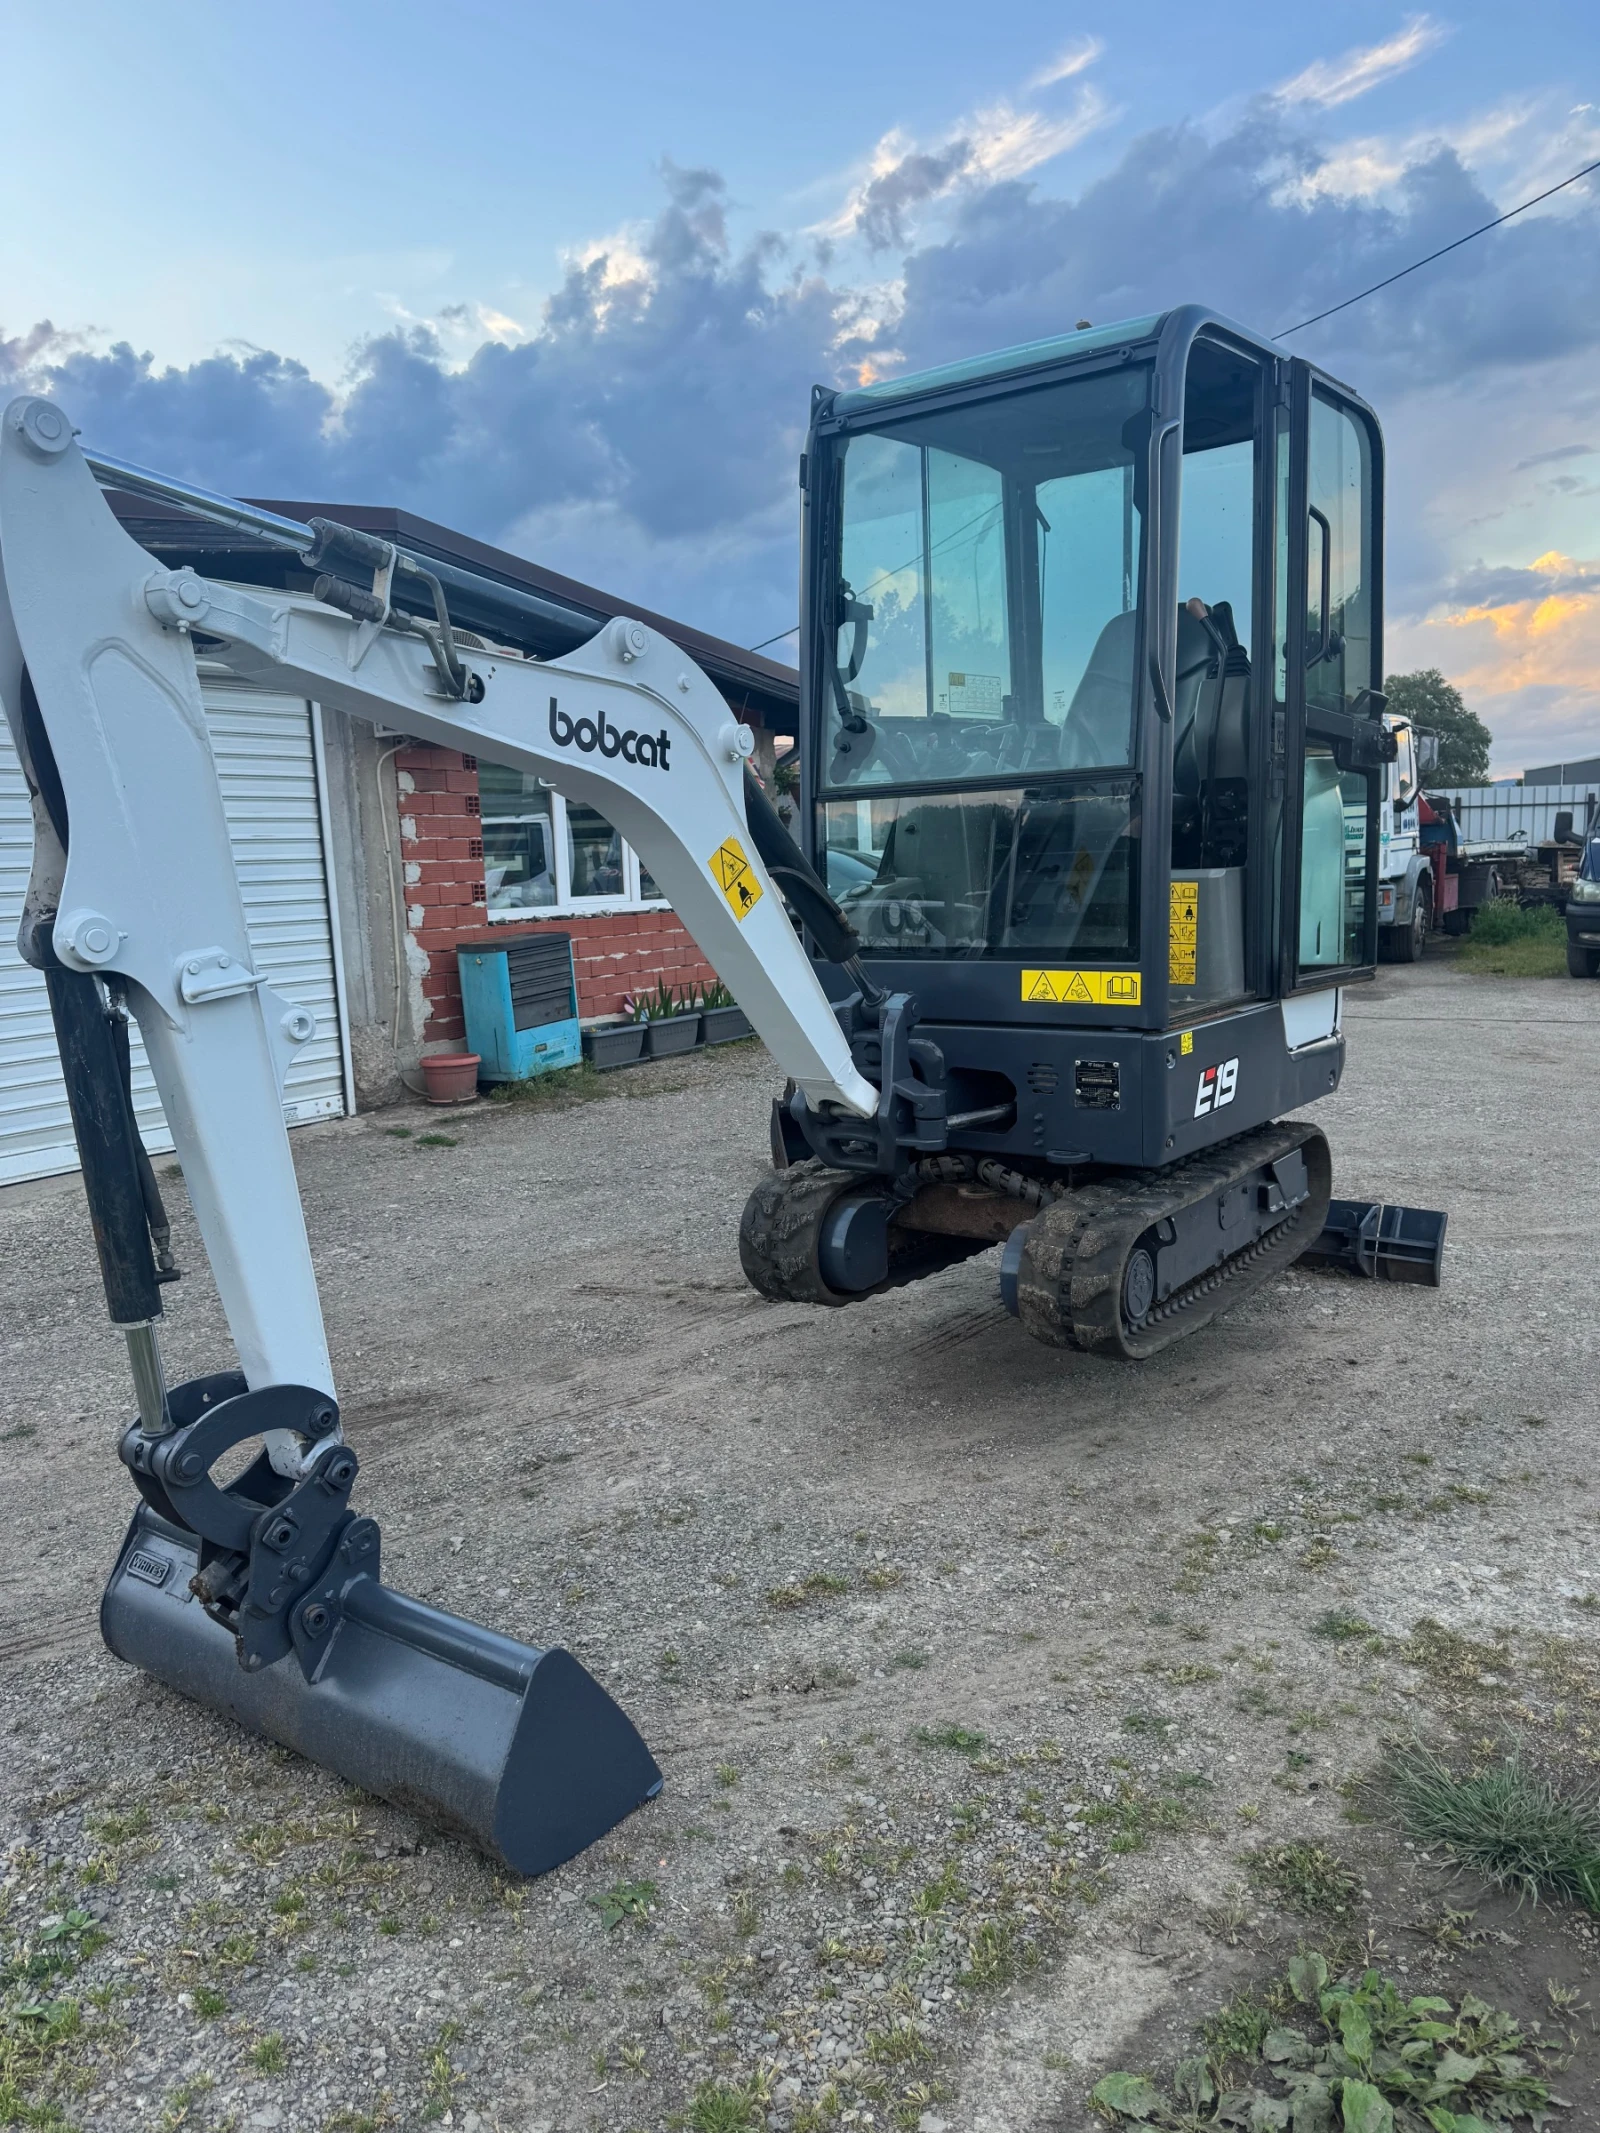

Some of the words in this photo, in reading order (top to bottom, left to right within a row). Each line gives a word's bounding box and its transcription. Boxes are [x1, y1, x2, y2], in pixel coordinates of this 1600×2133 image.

[549, 697, 671, 771] bobcat
[1194, 1057, 1239, 1118] E19
[133, 1556, 165, 1577] WHITES
